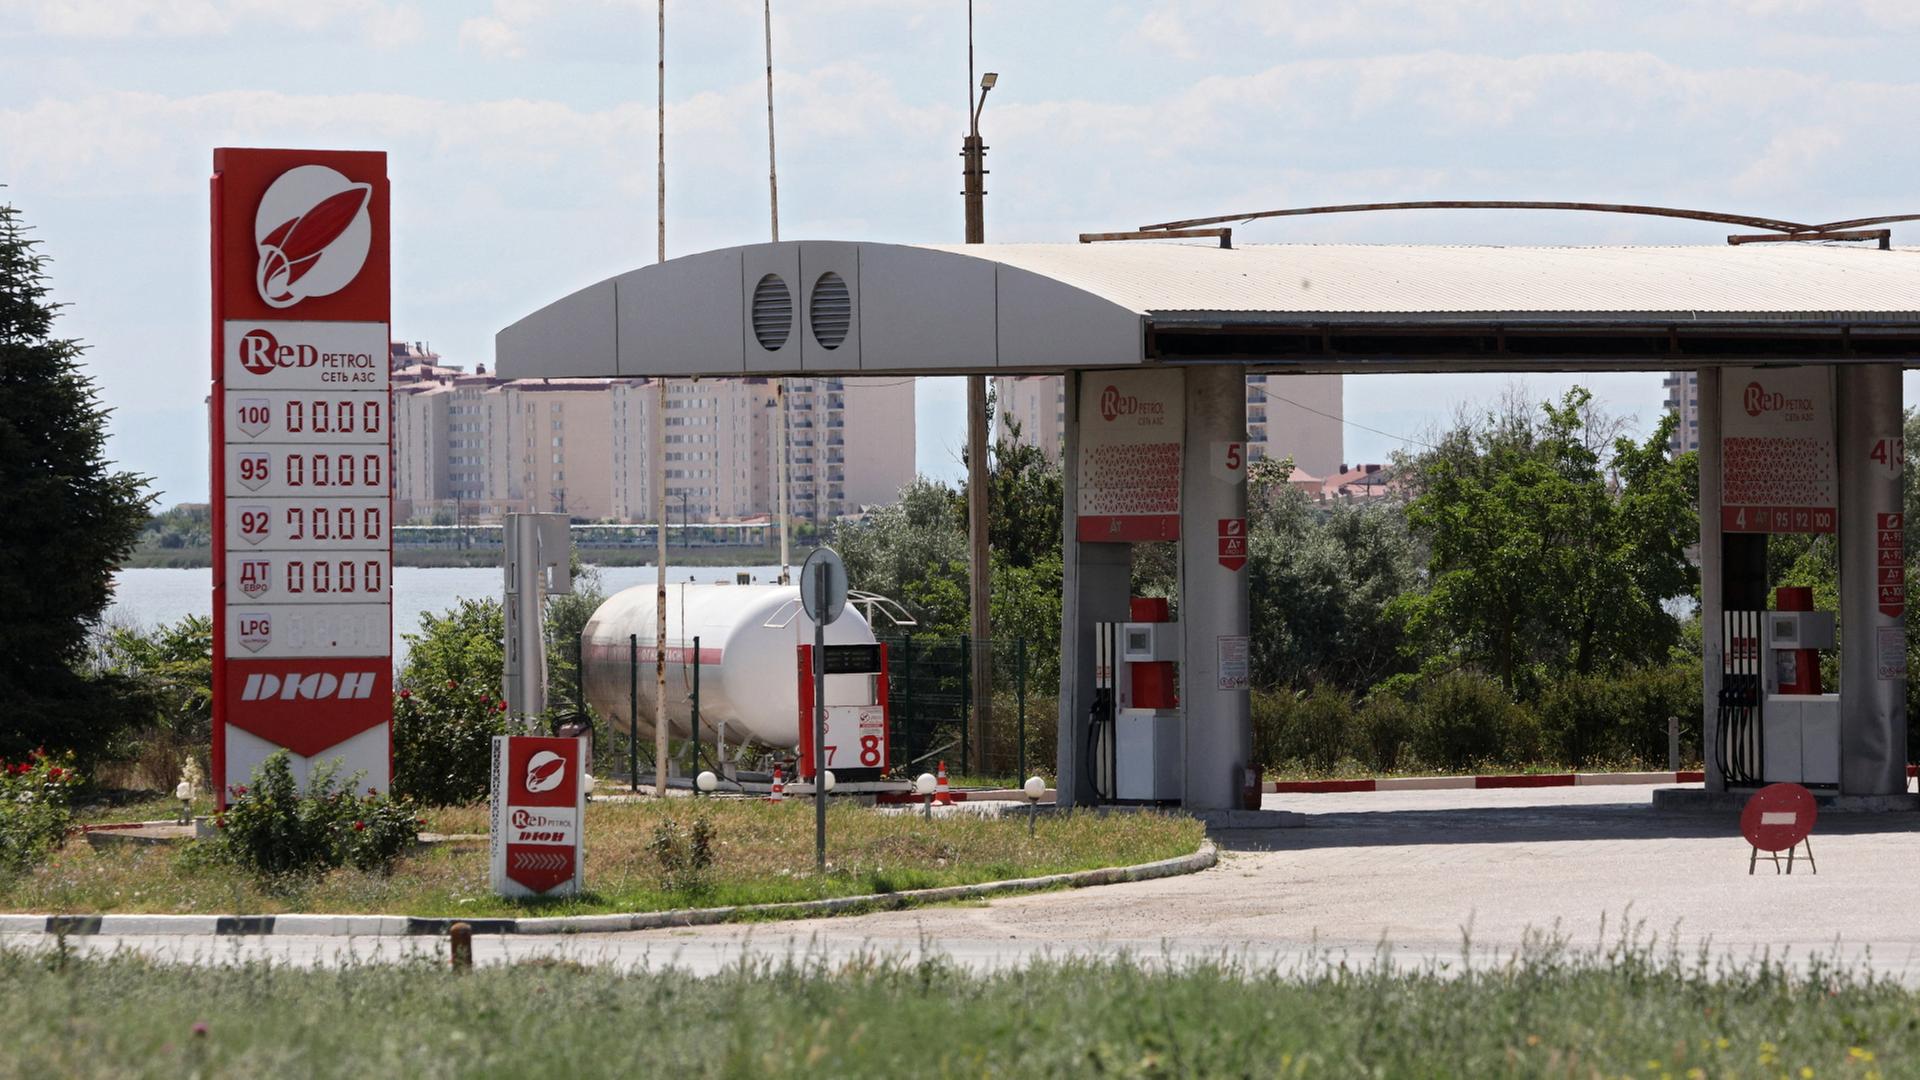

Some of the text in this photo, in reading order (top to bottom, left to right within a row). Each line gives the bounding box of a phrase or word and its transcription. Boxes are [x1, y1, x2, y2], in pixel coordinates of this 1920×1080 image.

[322, 353, 375, 369] PETROL
[321, 371, 376, 383] СЕТЬ АЗС
[1138, 402, 1164, 414] PETROL
[1785, 399, 1814, 411] PETROL
[238, 401, 380, 432] 100 00.00
[1226, 444, 1240, 469] 5
[240, 454, 381, 486] 95 00.00
[241, 512, 269, 534] 92
[1736, 509, 1746, 529] 4
[1776, 512, 1788, 528] 95
[1796, 512, 1808, 528] 92
[1815, 513, 1830, 528] 100
[240, 561, 381, 593] ДТ 00.00
[243, 584, 268, 593] ЕВРО
[240, 619, 269, 636] LPG
[860, 735, 881, 767] 8
